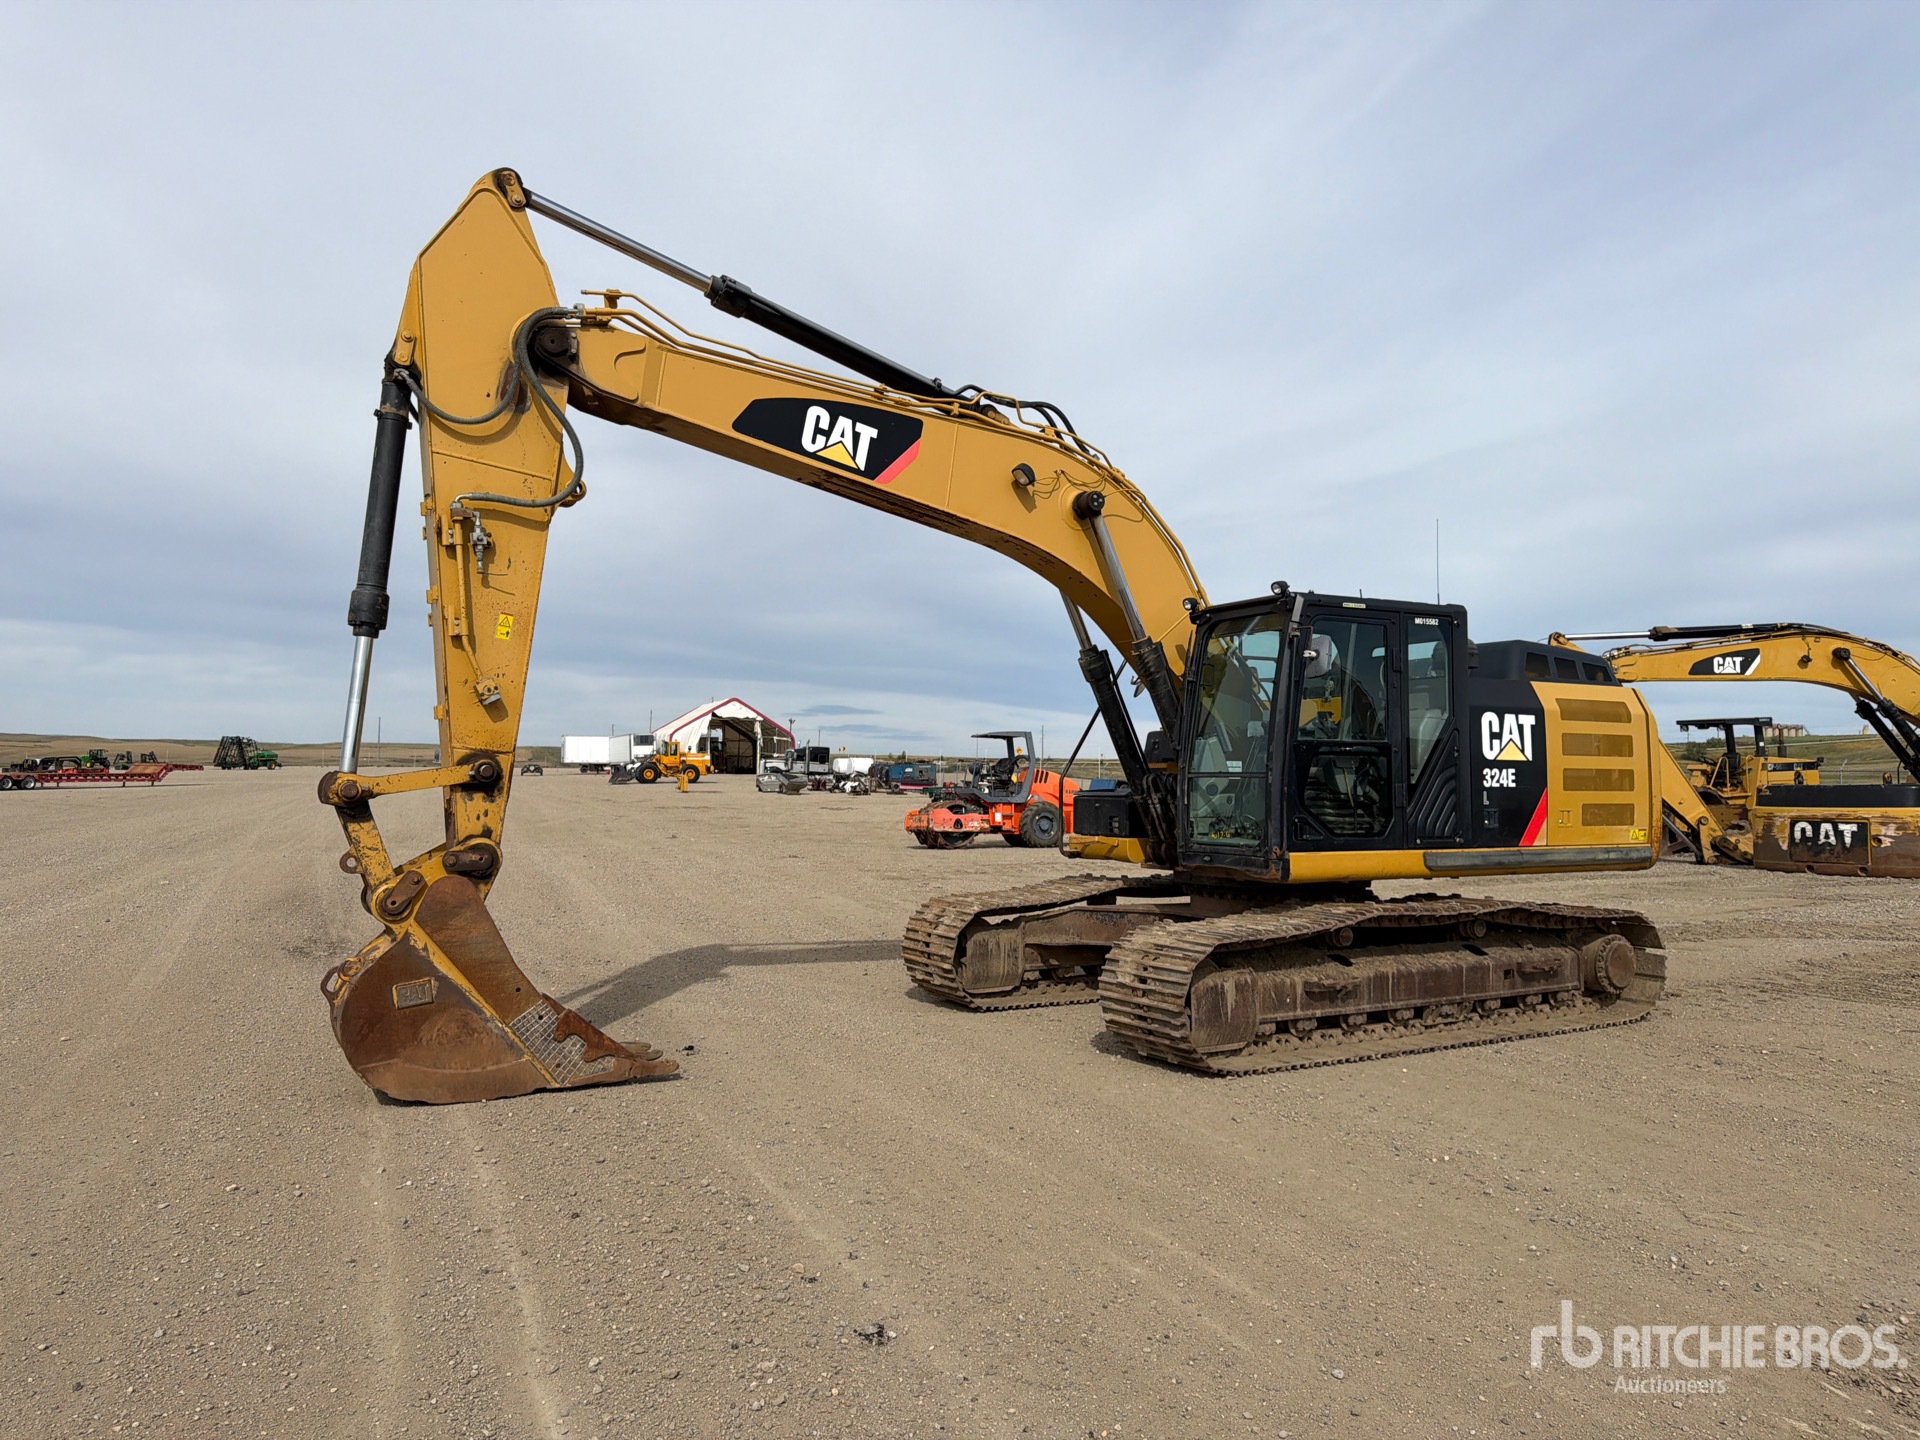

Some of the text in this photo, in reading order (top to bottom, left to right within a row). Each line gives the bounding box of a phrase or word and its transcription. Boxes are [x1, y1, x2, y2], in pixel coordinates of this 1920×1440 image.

[801, 405, 879, 471] CAT
[1713, 656, 1743, 674] CAT
[1481, 711, 1536, 761] CAT
[1482, 768, 1516, 788] 324E
